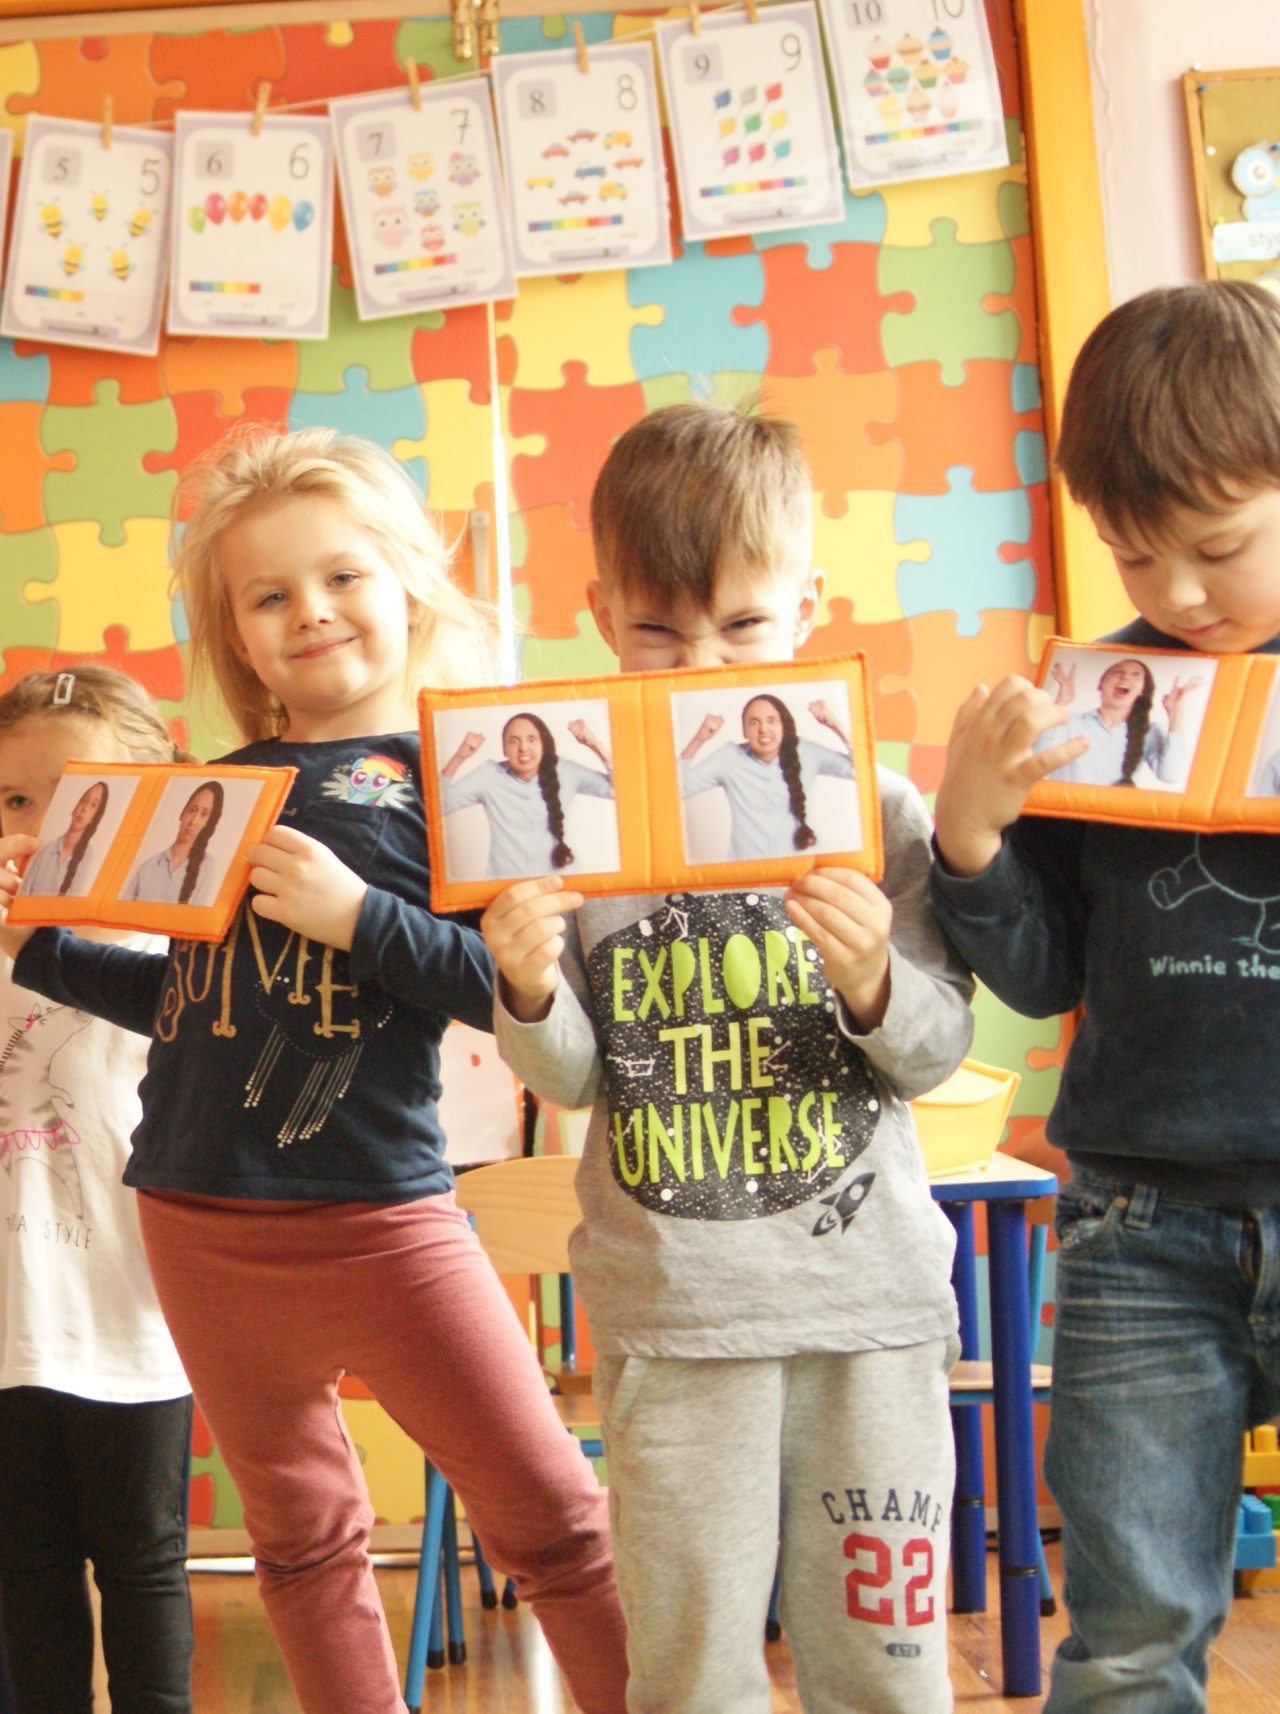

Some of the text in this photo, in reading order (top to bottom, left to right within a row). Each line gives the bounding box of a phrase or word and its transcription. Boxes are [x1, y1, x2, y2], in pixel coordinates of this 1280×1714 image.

[851, 0, 882, 26] 10
[694, 53, 711, 78] 9
[780, 33, 802, 71] 9
[530, 89, 546, 113] 8
[617, 73, 638, 111] 8
[367, 132, 383, 156] 7
[449, 107, 471, 145] 7
[52, 156, 70, 182] 5
[138, 157, 160, 196] 5
[206, 151, 222, 175] 6
[288, 142, 310, 180] 6
[613, 929, 821, 1022] EXPLORE
[1150, 953, 1280, 980] Winnie the
[658, 1016, 775, 1095] THE
[613, 1090, 846, 1187] UNIVERSE
[44, 1219, 93, 1249] STYLE
[842, 1531, 935, 1627] 22
